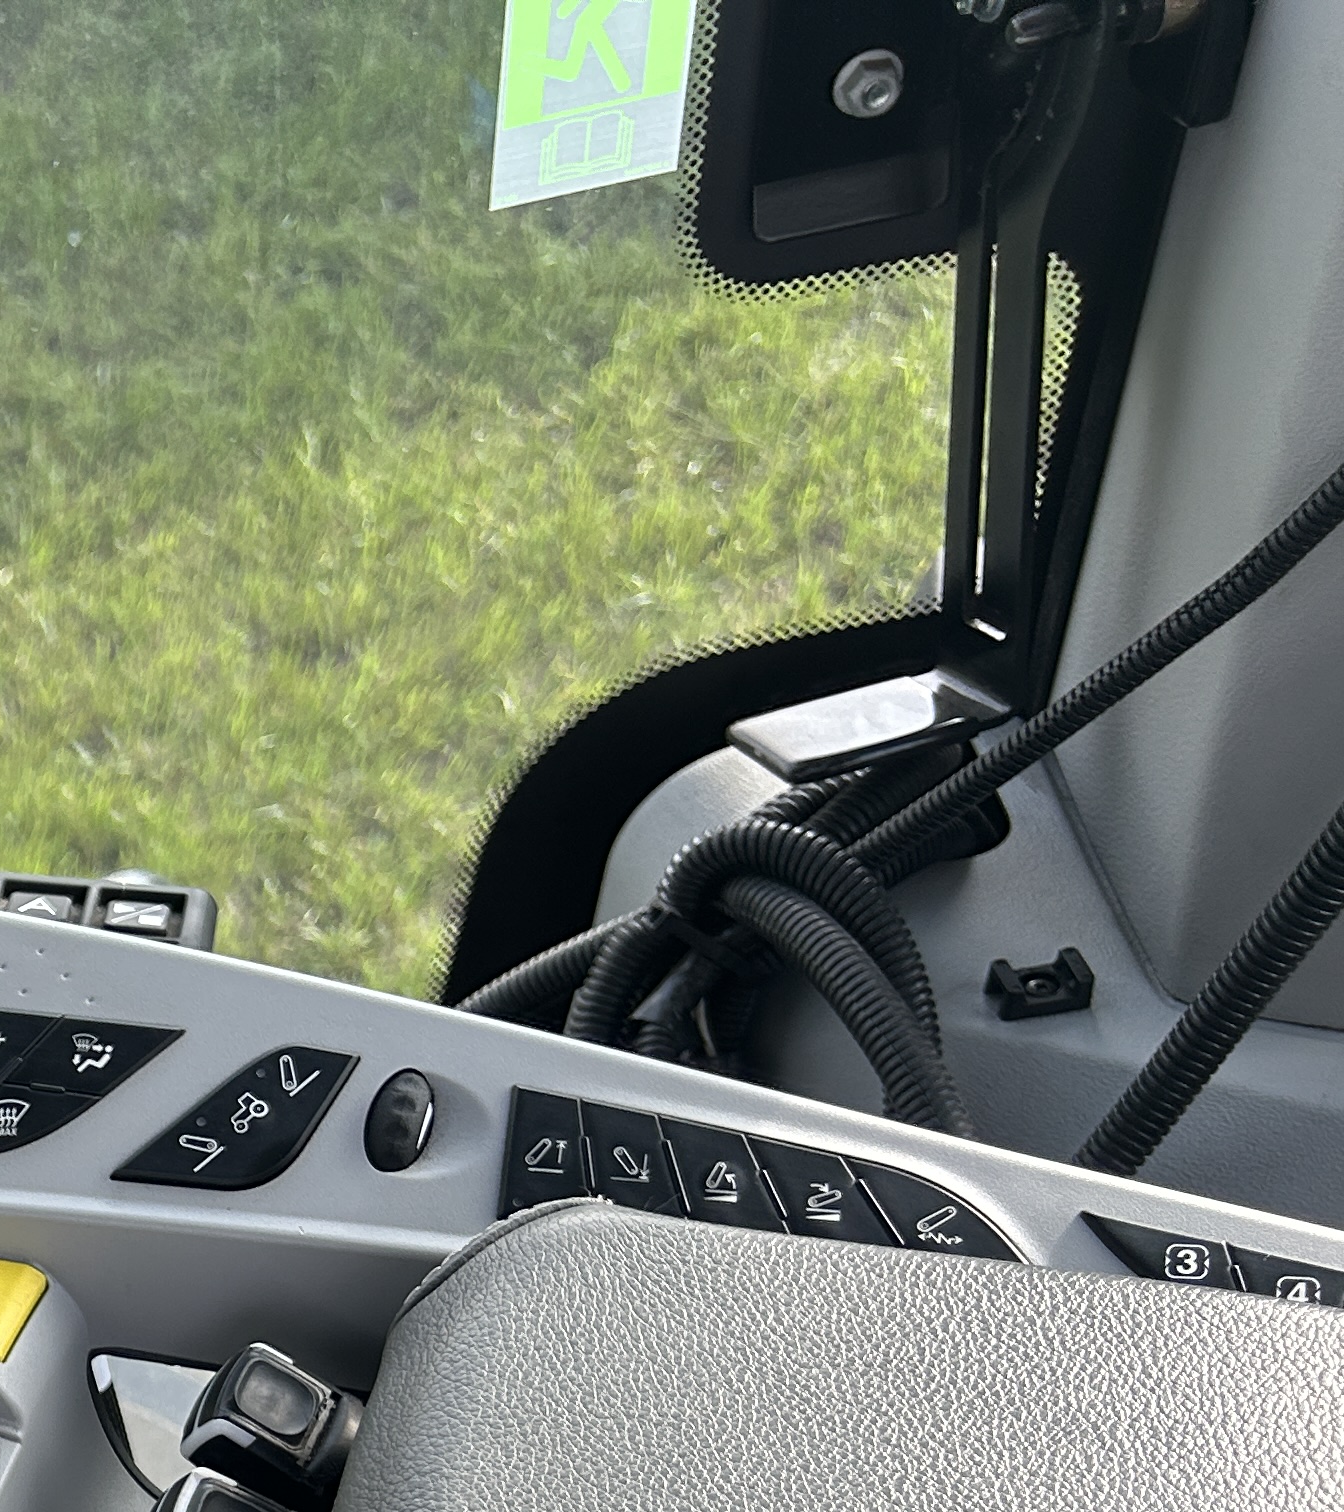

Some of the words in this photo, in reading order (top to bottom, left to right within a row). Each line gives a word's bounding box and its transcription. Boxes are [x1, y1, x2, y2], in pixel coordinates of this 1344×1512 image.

[17, 895, 57, 916] A
[1175, 1248, 1199, 1276] 3
[1286, 1281, 1310, 1303] 4
